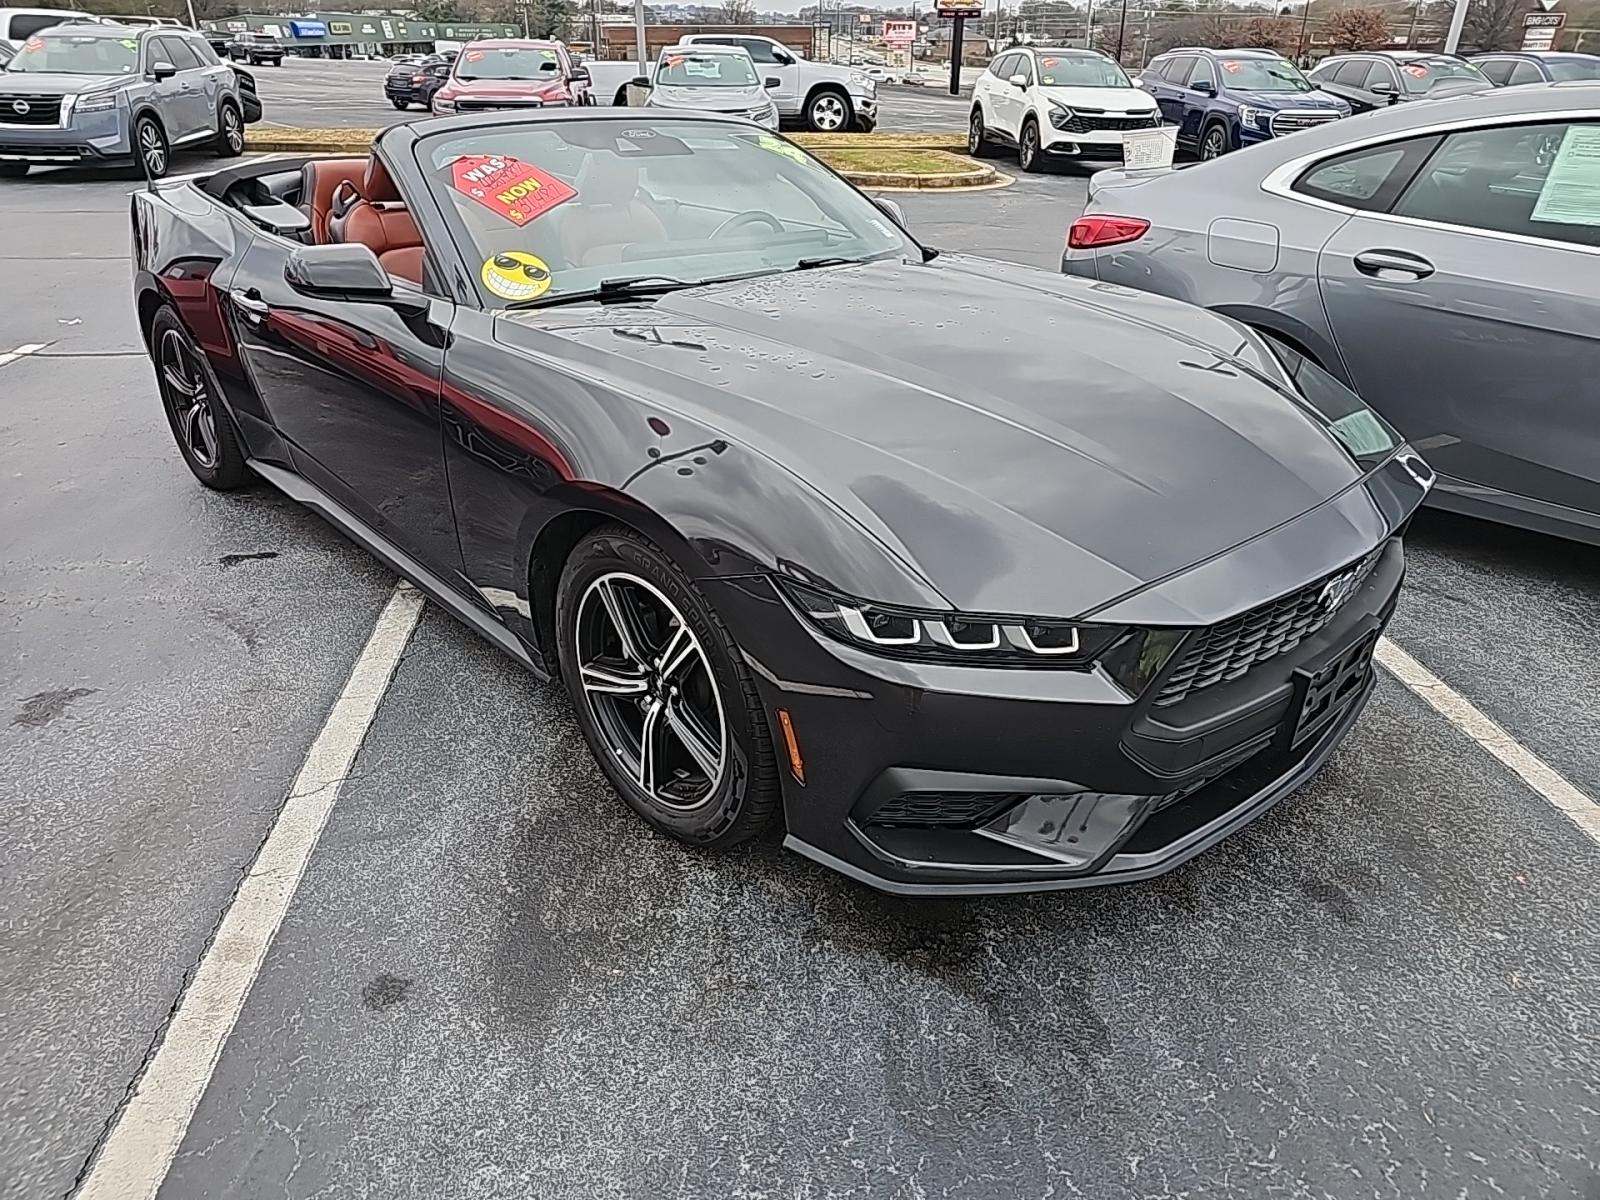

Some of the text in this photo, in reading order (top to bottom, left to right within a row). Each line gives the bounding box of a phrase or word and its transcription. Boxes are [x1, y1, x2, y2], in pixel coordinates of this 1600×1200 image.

[462, 158, 506, 183] WAS
[495, 176, 543, 206] NOW
[634, 552, 680, 597] GRAND
